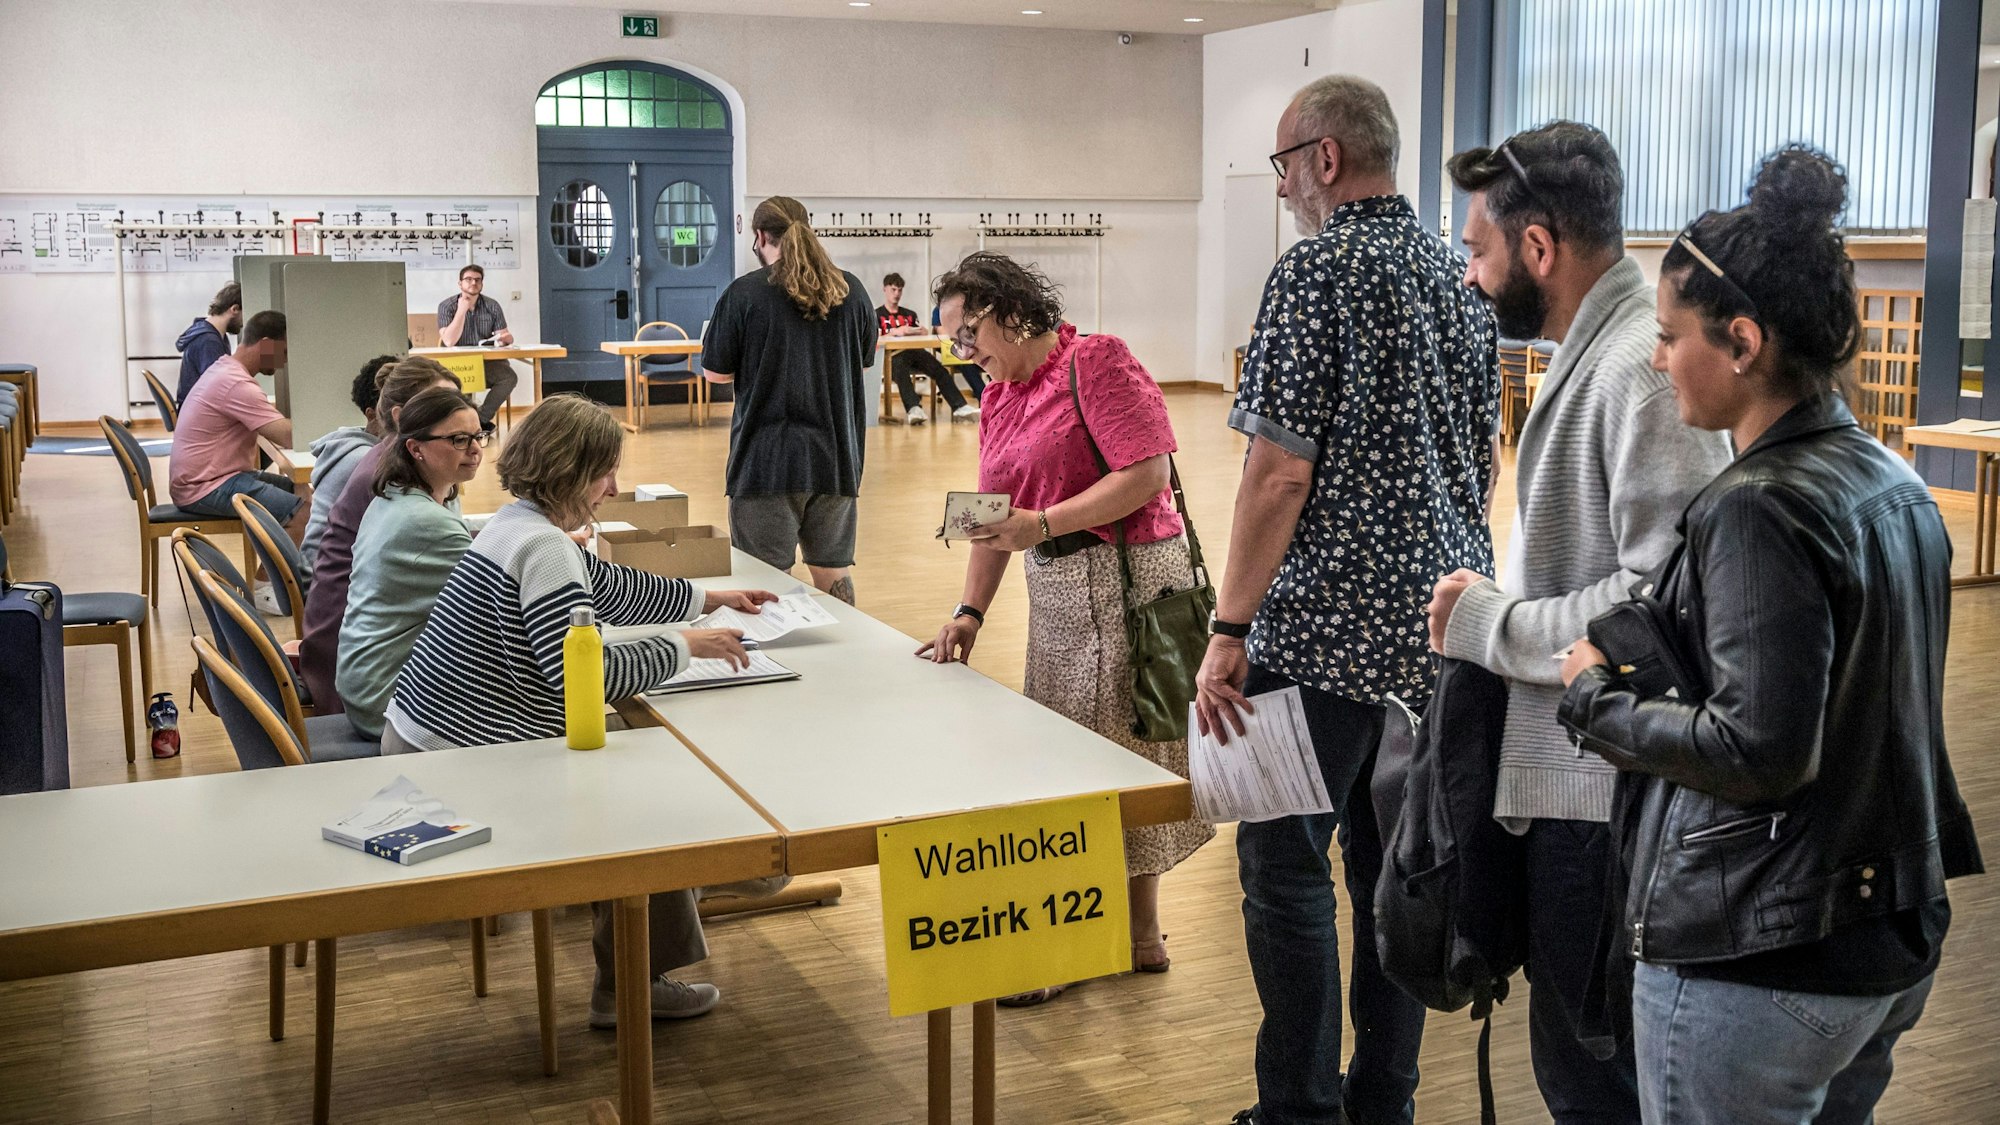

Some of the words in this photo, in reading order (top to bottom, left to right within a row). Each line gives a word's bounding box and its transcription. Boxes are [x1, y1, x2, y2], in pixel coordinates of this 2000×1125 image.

[676, 231, 694, 240] WC
[463, 375, 475, 383] 122
[914, 821, 1087, 879] Wahllokal
[908, 901, 1030, 951] Bezirk
[1042, 887, 1104, 926] 122
